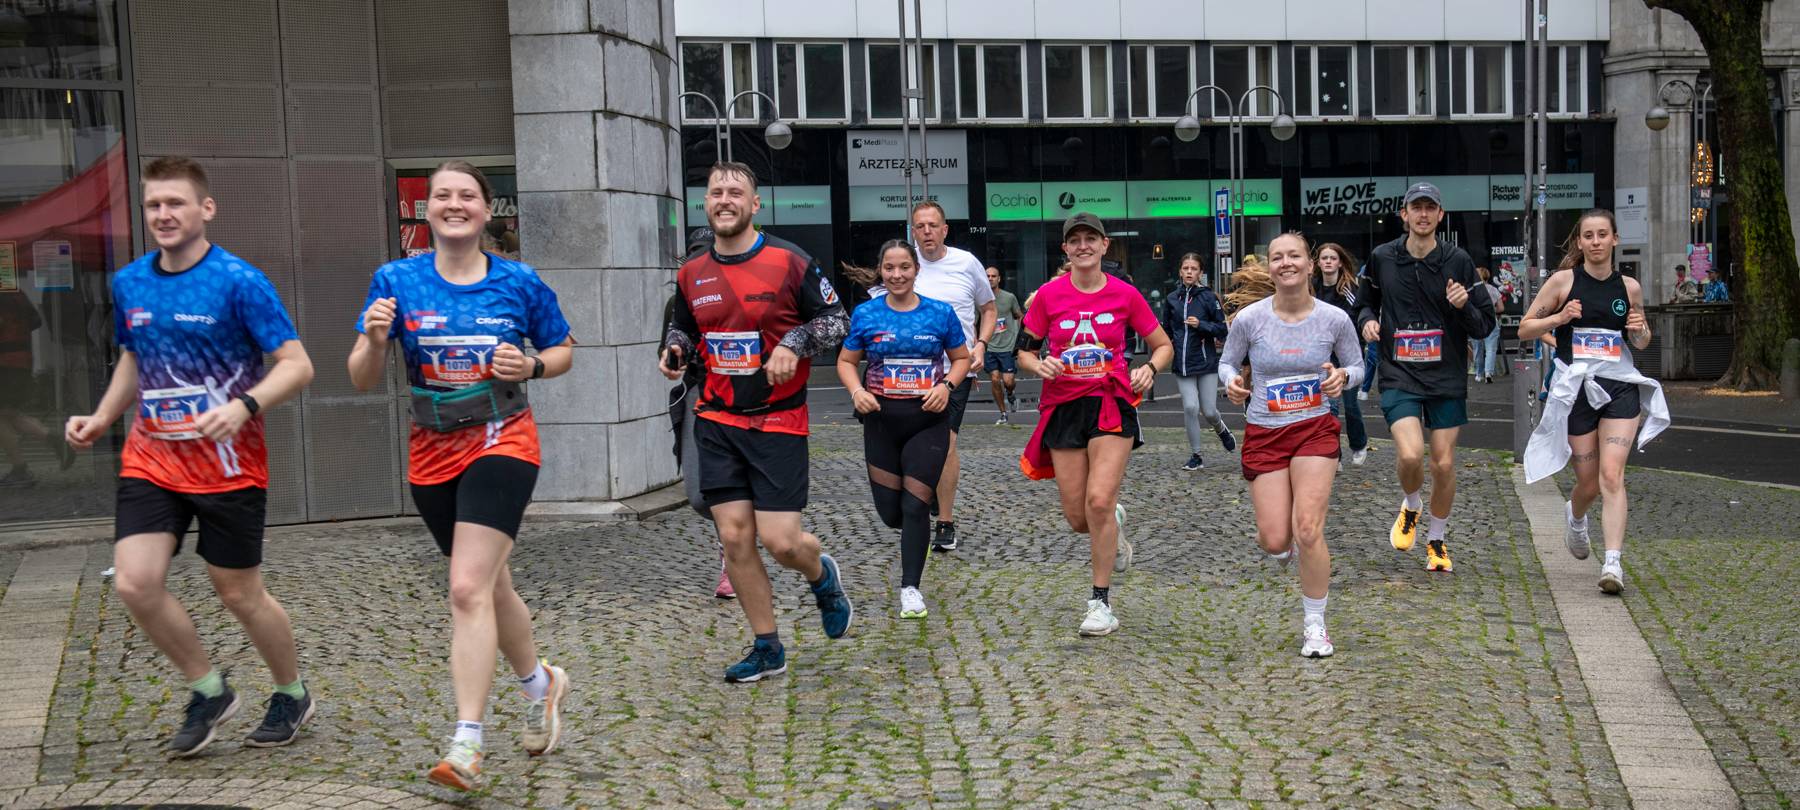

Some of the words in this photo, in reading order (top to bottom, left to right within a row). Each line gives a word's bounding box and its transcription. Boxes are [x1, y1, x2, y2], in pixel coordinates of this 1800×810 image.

[1492, 185, 1520, 193] Picture
[1545, 183, 1578, 191] OTOSTUDIO
[1306, 187, 1331, 206] WE
[1334, 182, 1377, 202] LOVE
[1492, 192, 1520, 202] People
[990, 193, 1038, 208] Occhio
[1303, 203, 1348, 217] YOUR
[1352, 196, 1406, 216] STORIE
[970, 226, 987, 234] 17-19
[1491, 246, 1524, 255] ZENTRALE
[475, 317, 508, 326] CRAFT
[446, 360, 471, 370] 1070
[900, 374, 916, 382] 1071
[1285, 392, 1303, 402] 1072
[1279, 401, 1311, 410] FRANZISKA
